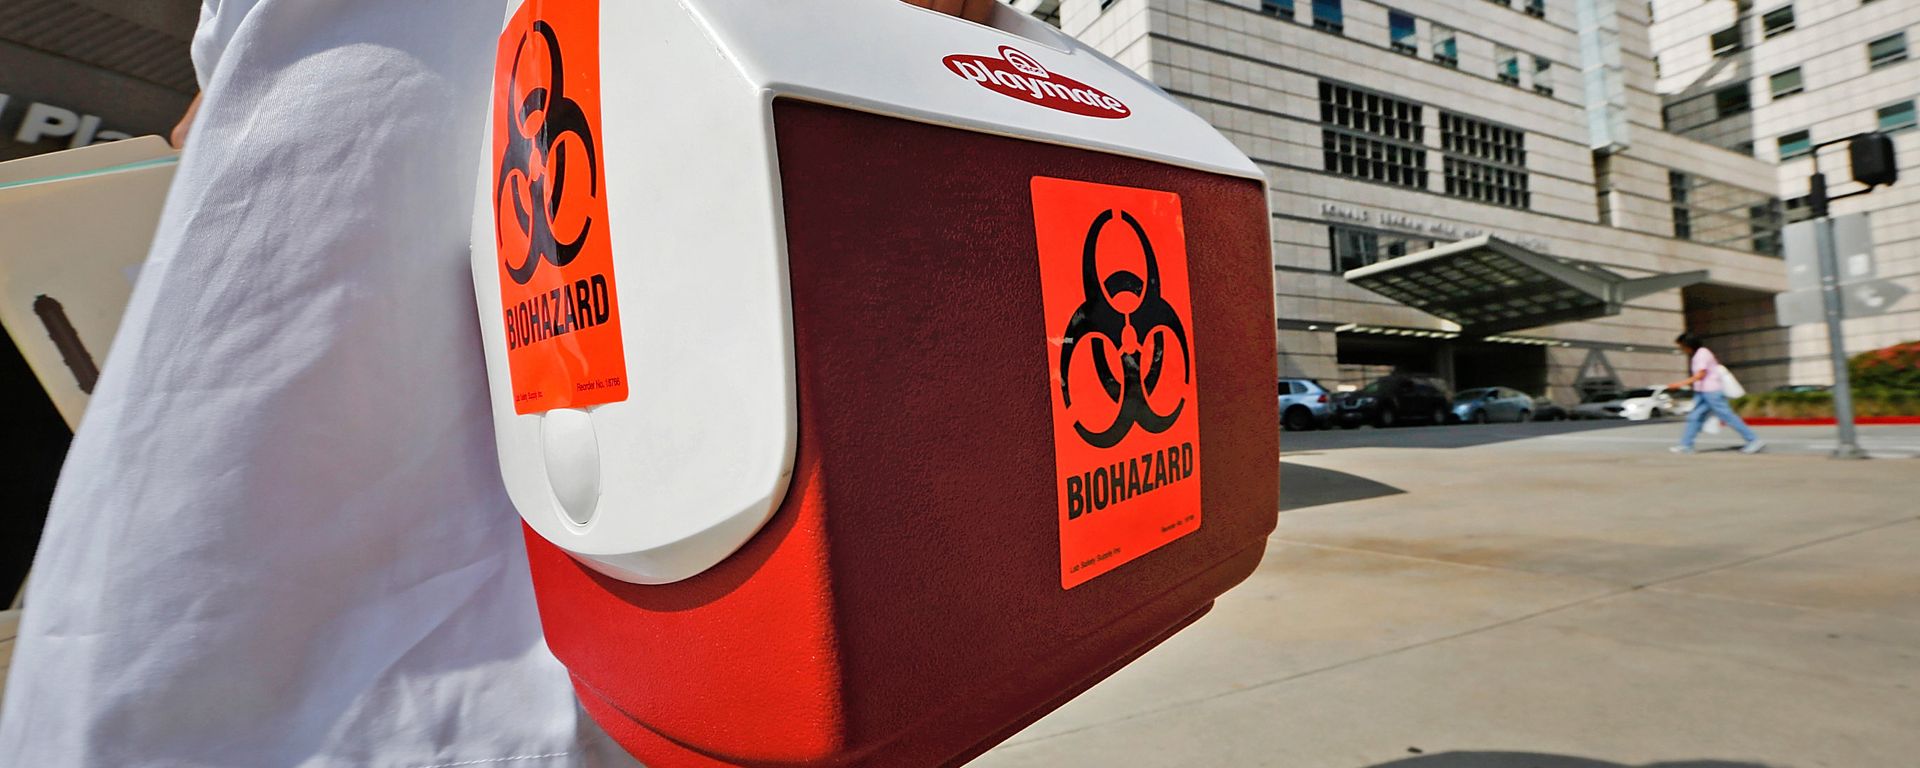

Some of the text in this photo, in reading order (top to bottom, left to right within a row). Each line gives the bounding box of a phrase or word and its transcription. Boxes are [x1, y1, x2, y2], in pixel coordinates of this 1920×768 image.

[952, 59, 1127, 114] playmate
[506, 273, 610, 351] BIOHAZARD
[1066, 441, 1193, 520] BIOHAZARD
